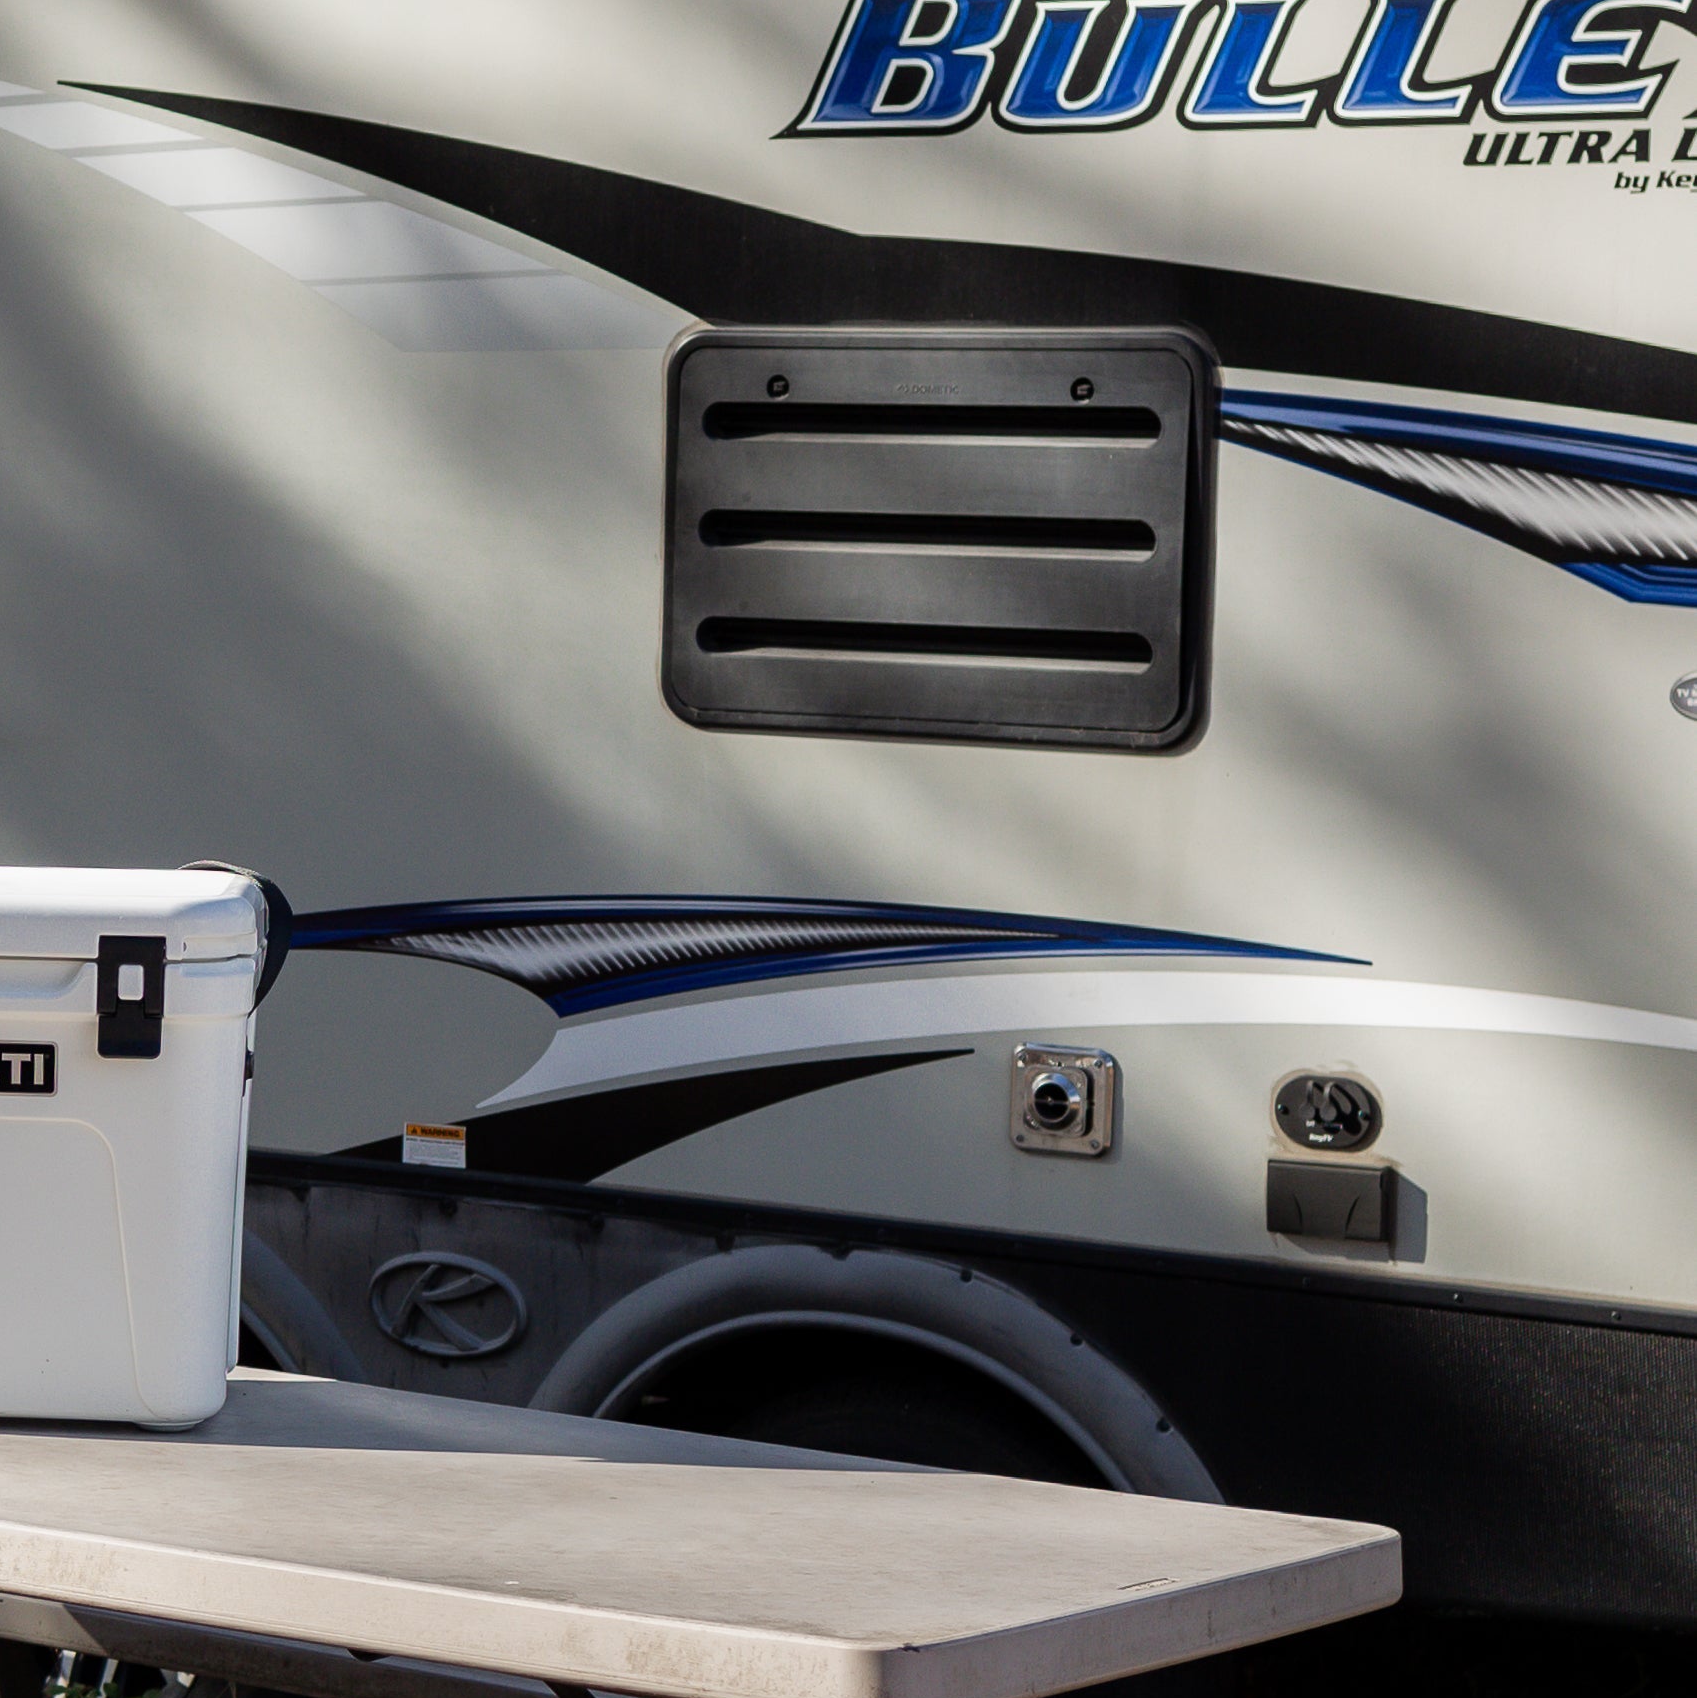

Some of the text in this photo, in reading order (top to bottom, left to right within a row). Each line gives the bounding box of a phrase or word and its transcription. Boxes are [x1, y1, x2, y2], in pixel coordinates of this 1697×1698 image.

[1463, 128, 1651, 166] ULTRA
[1614, 170, 1697, 194] by Ke
[421, 1126, 460, 1138] WARNING
